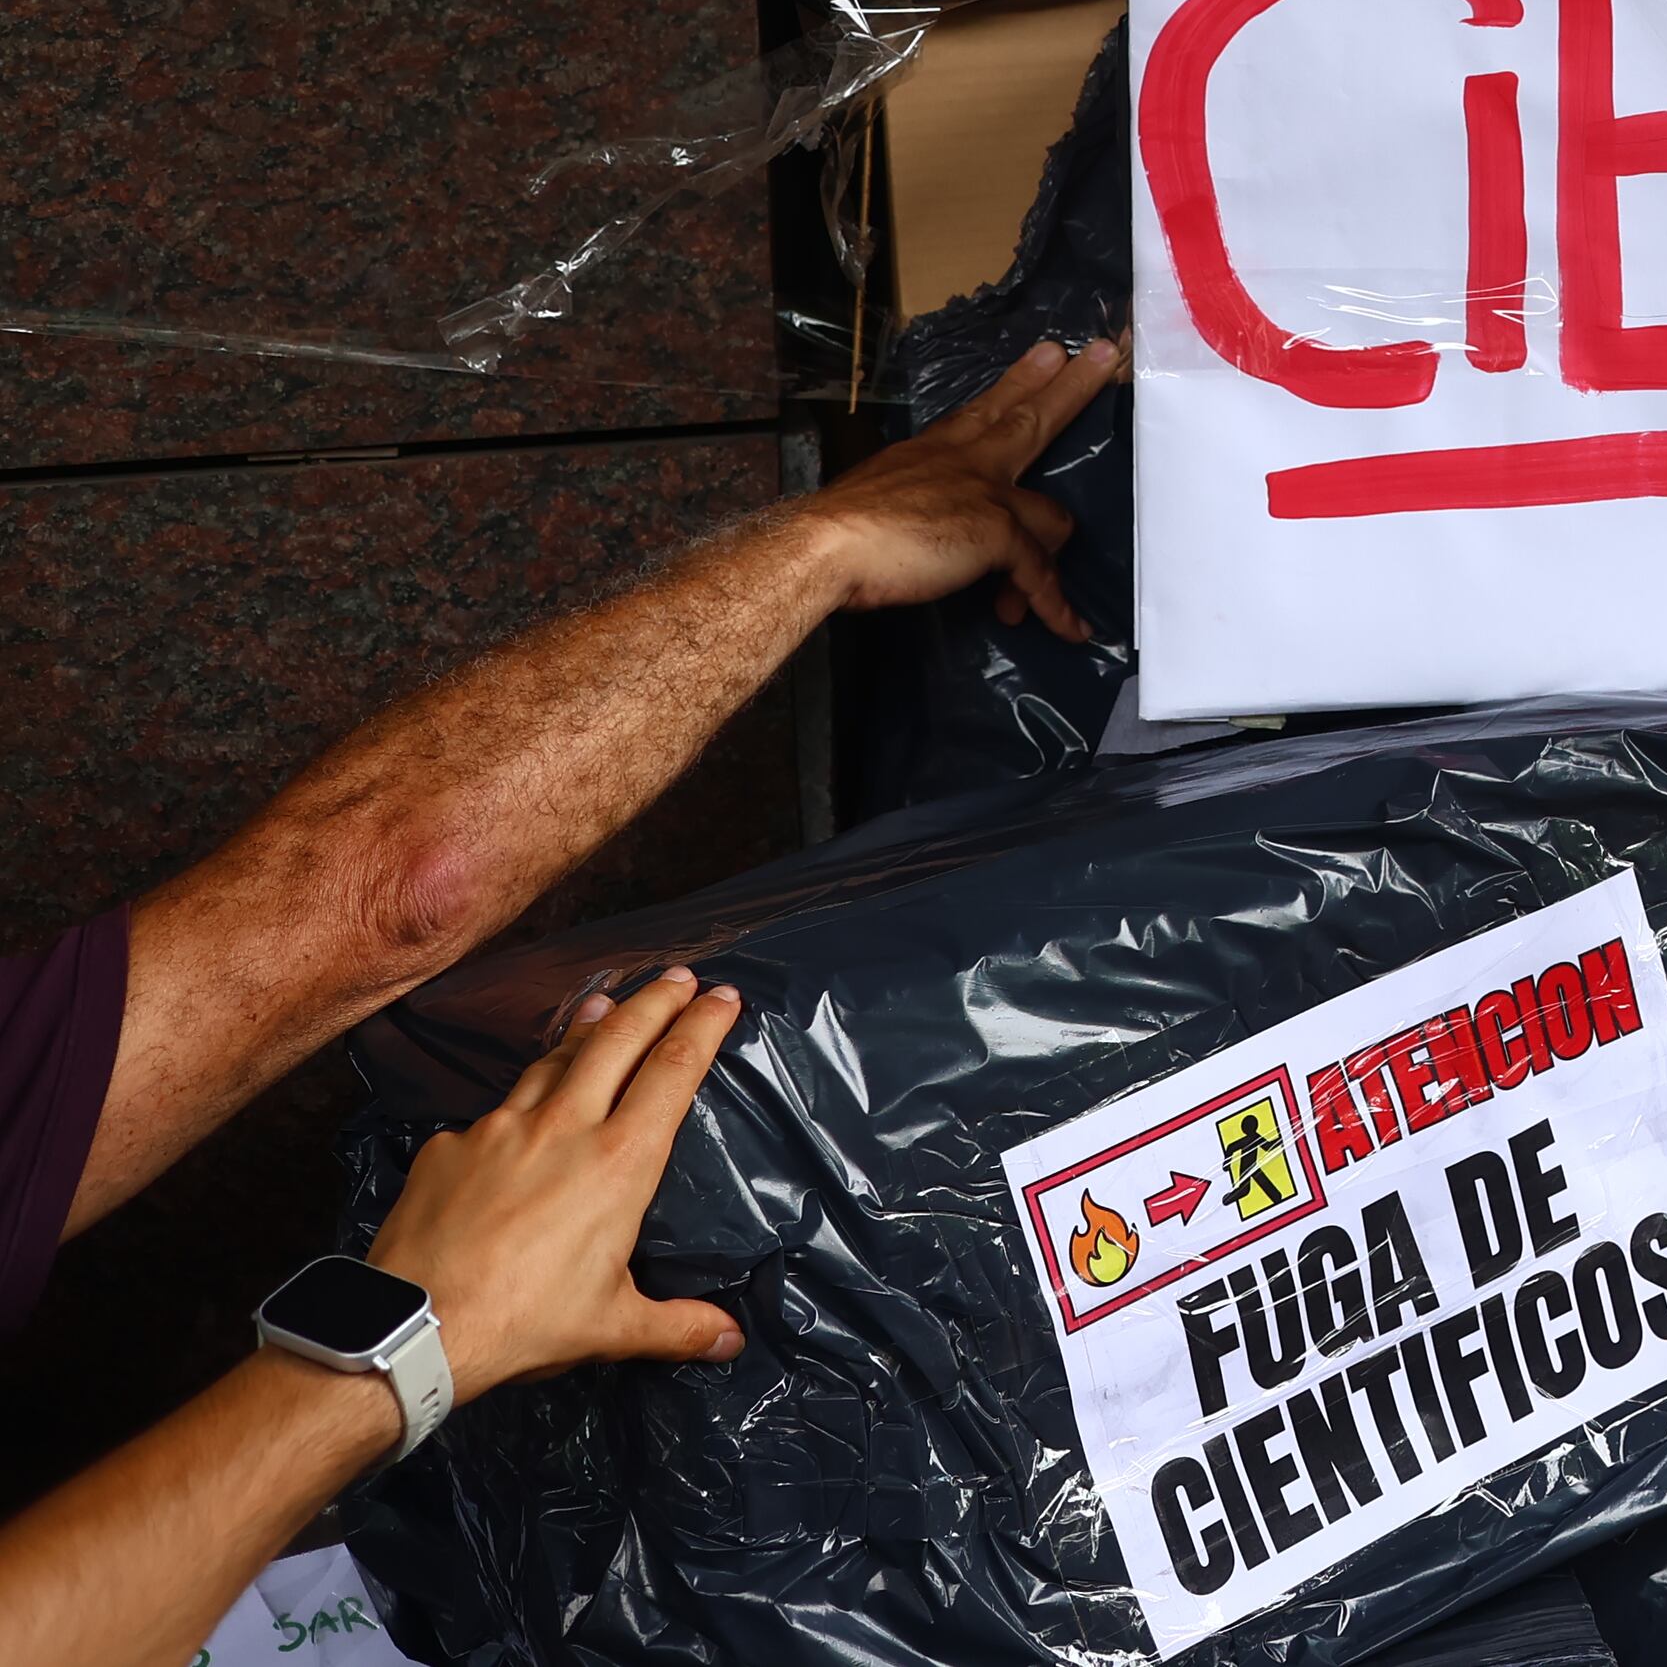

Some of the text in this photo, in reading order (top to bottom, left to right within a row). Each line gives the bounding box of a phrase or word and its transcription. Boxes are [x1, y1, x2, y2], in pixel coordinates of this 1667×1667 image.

[1305, 940, 1643, 1175] ATENCION
[1178, 1119, 1580, 1425] FUGA DE
